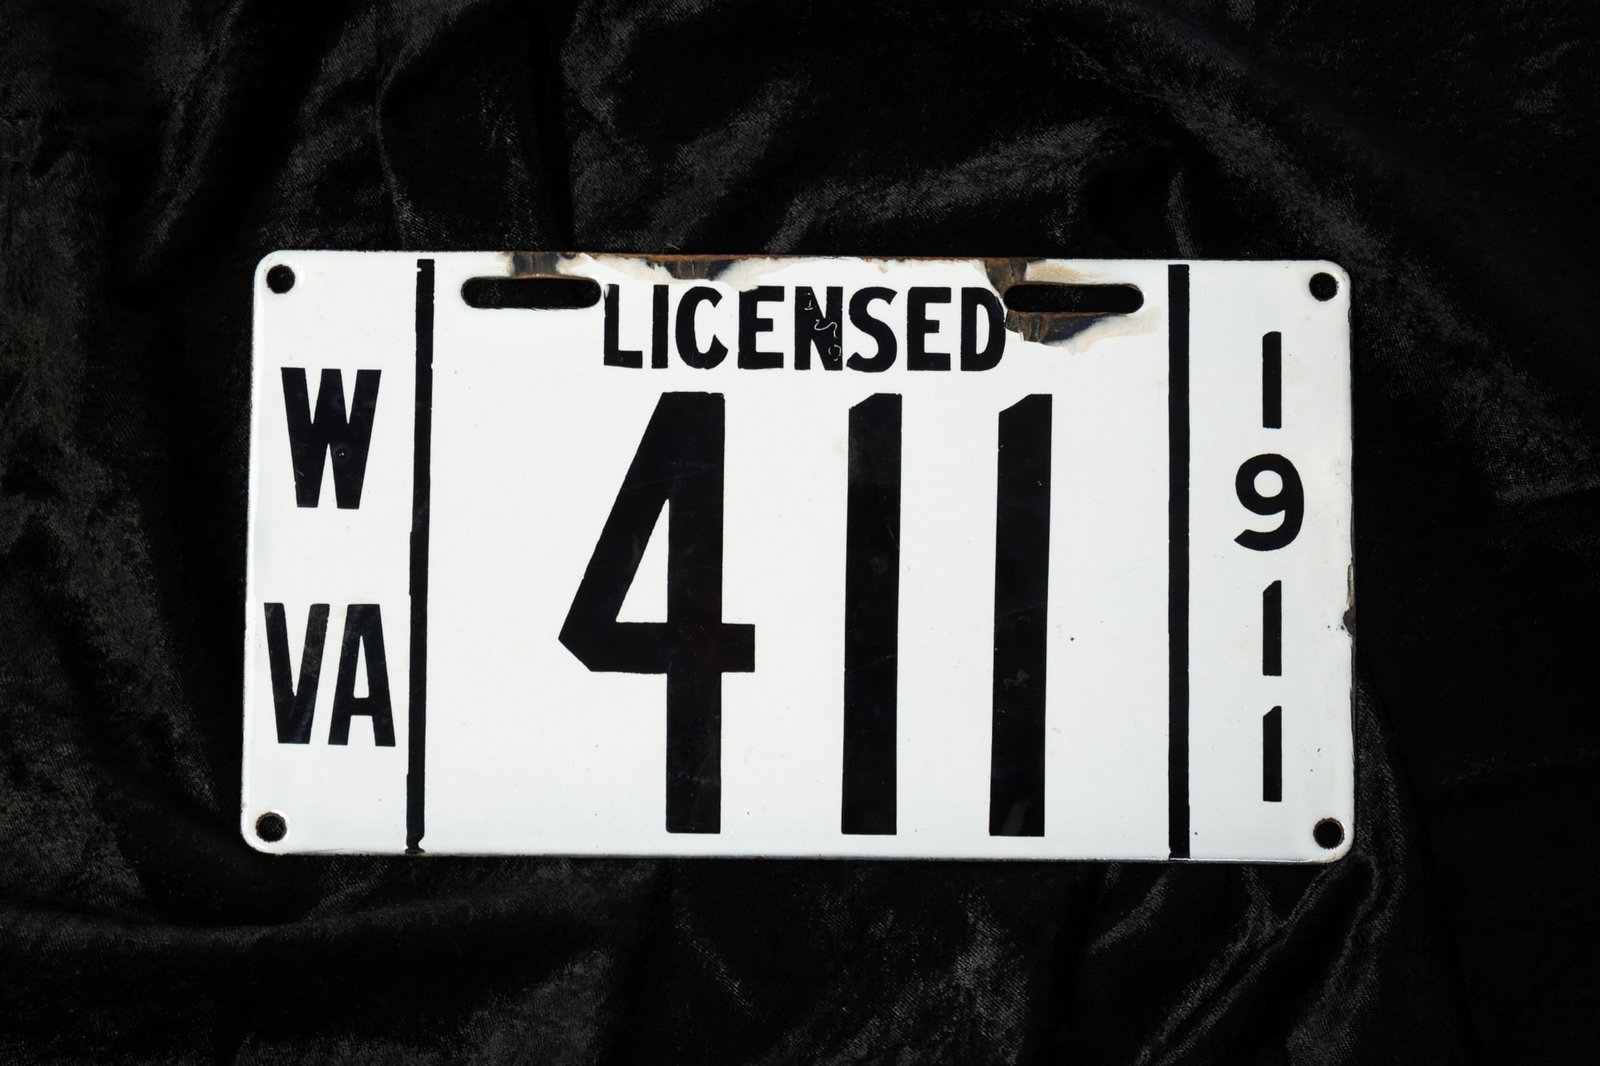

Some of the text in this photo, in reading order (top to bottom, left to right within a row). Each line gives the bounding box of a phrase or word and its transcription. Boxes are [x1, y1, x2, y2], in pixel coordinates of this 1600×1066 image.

[603, 284, 1006, 372] LICENSED
[281, 367, 381, 509] W
[558, 392, 1052, 837] 411
[1234, 332, 1304, 802] 1911
[264, 603, 395, 747] VA
